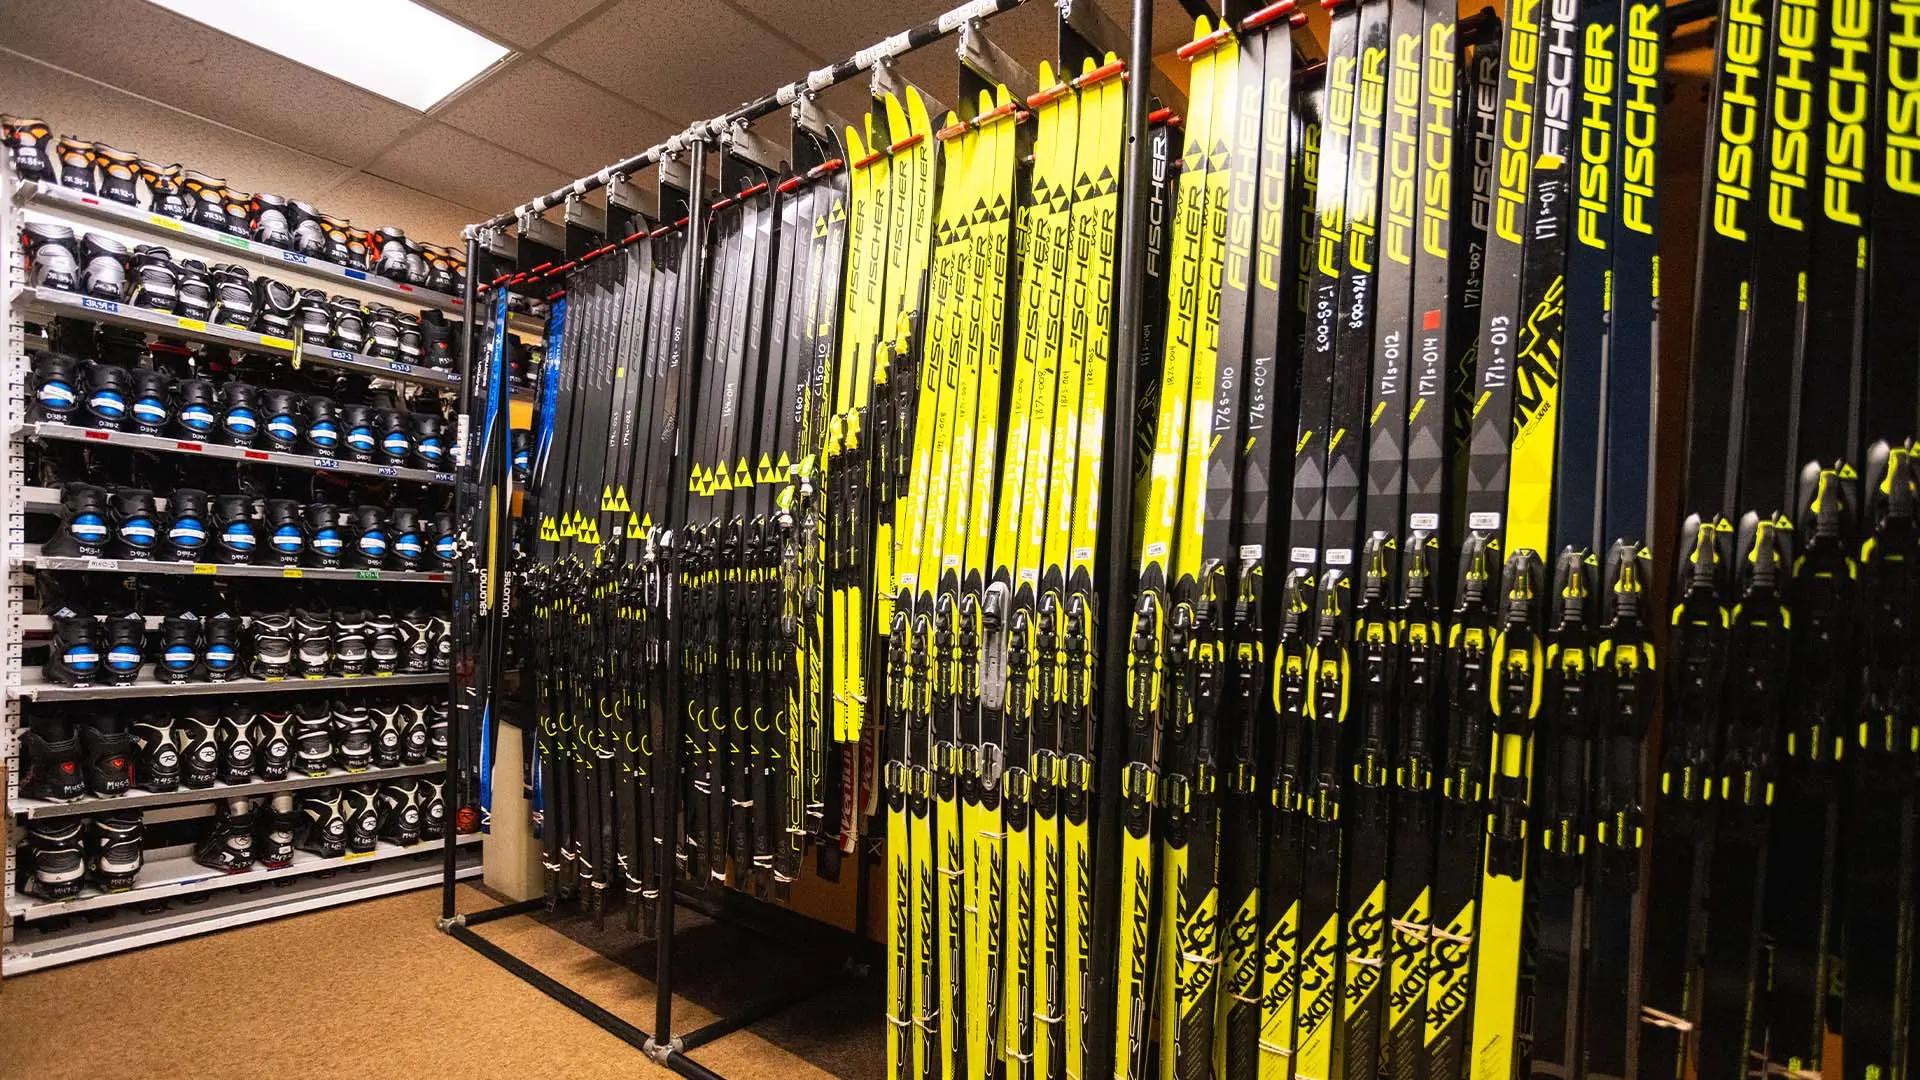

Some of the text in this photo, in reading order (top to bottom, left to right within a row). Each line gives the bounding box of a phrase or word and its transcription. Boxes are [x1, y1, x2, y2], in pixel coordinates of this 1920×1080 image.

[1258, 77, 1291, 292] FISCHER
[1317, 55, 1358, 280] FISHER
[1349, 47, 1388, 274] FISCHER
[1387, 32, 1422, 266] FISCHER
[1423, 22, 1457, 260] FISCHER
[1471, 55, 1499, 232] FISCHER
[1495, 0, 1541, 245] FISCHER
[1577, 22, 1616, 251] FISCHER
[1622, 3, 1661, 236] FISCHER
[1768, 0, 1819, 233] FISCHE
[849, 199, 866, 314] FISCHER
[867, 188, 885, 304] FISCHER
[893, 160, 908, 269] FISCHER
[914, 145, 928, 244] FISCHER
[1146, 135, 1168, 278] FISCHER
[1227, 84, 1260, 292] FISCHER
[646, 279, 662, 378] FISCHER
[657, 279, 674, 378] FISCHER
[705, 255, 724, 362] FISCHER
[717, 256, 735, 364] FISCHER
[750, 236, 768, 350] FISCHER
[773, 230, 793, 344] FISCHER
[791, 226, 811, 341] FISCHER
[806, 243, 824, 341] FISCHER
[927, 256, 951, 393] FISCHER
[946, 252, 969, 390] FISCHER
[966, 235, 988, 375] FISCHER
[988, 233, 1007, 375] FISCHER
[1023, 217, 1050, 365] FISCHER
[1043, 225, 1067, 375] FISCHER
[1069, 214, 1094, 366] FISCHER
[1094, 208, 1115, 362] FISCHER
[1176, 185, 1204, 348] FISCHER
[1207, 185, 1230, 353] FISCHER
[605, 291, 621, 385] FISCHER
[813, 343, 826, 397] C150-10
[479, 568, 488, 617] salomon
[502, 570, 513, 618] salomon
